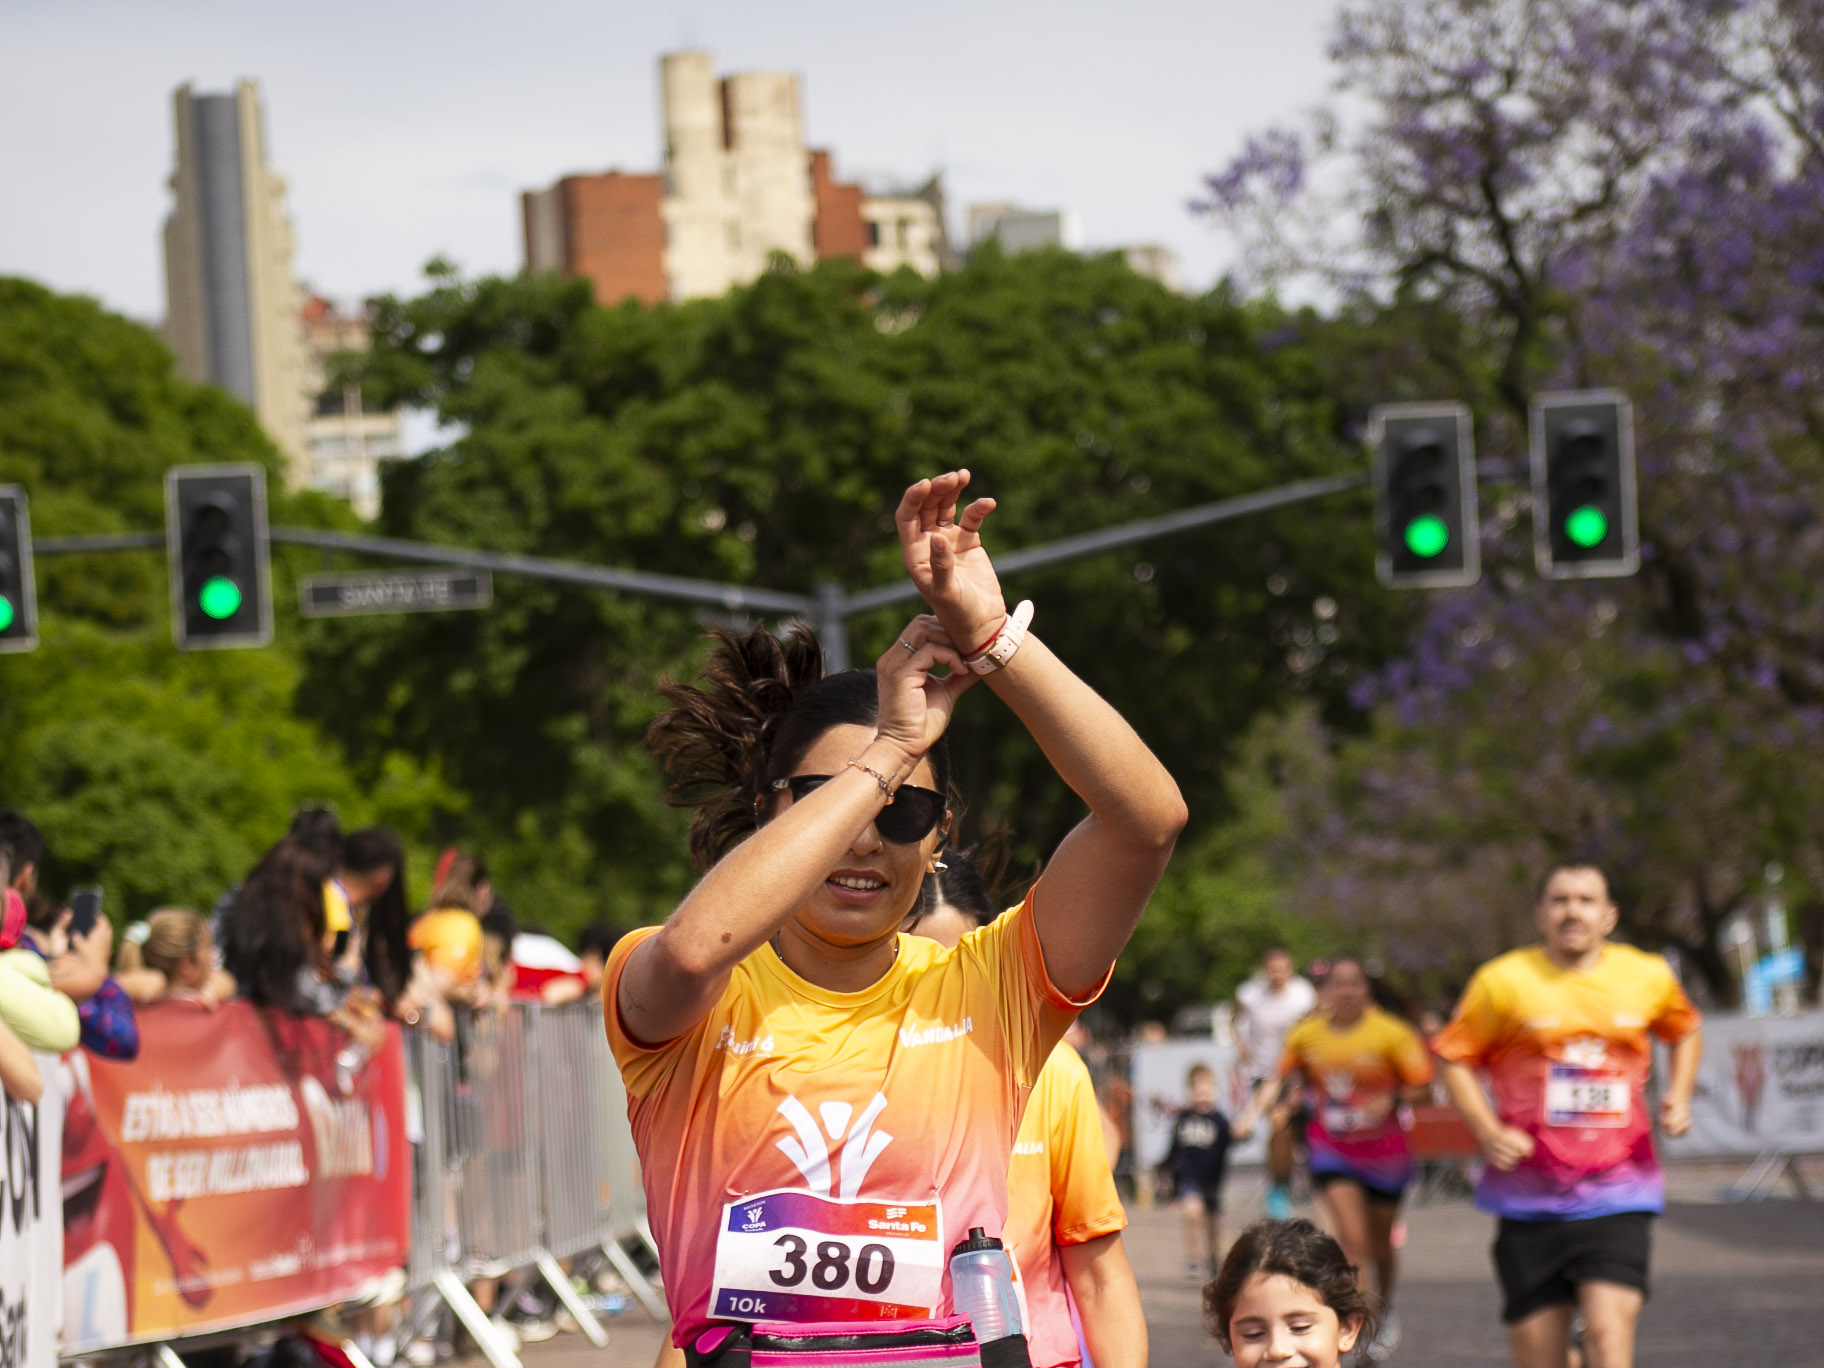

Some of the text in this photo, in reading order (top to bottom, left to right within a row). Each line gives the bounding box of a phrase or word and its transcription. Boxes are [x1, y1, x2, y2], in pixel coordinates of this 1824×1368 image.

[899, 1016, 973, 1048] VANDALIA
[761, 1036, 774, 1052] 6
[1012, 1141, 1044, 1155] ALIA
[741, 1221, 767, 1230] COPA
[868, 1219, 927, 1233] Santa Fe
[769, 1234, 895, 1294] 380
[729, 1297, 767, 1314] 10k
